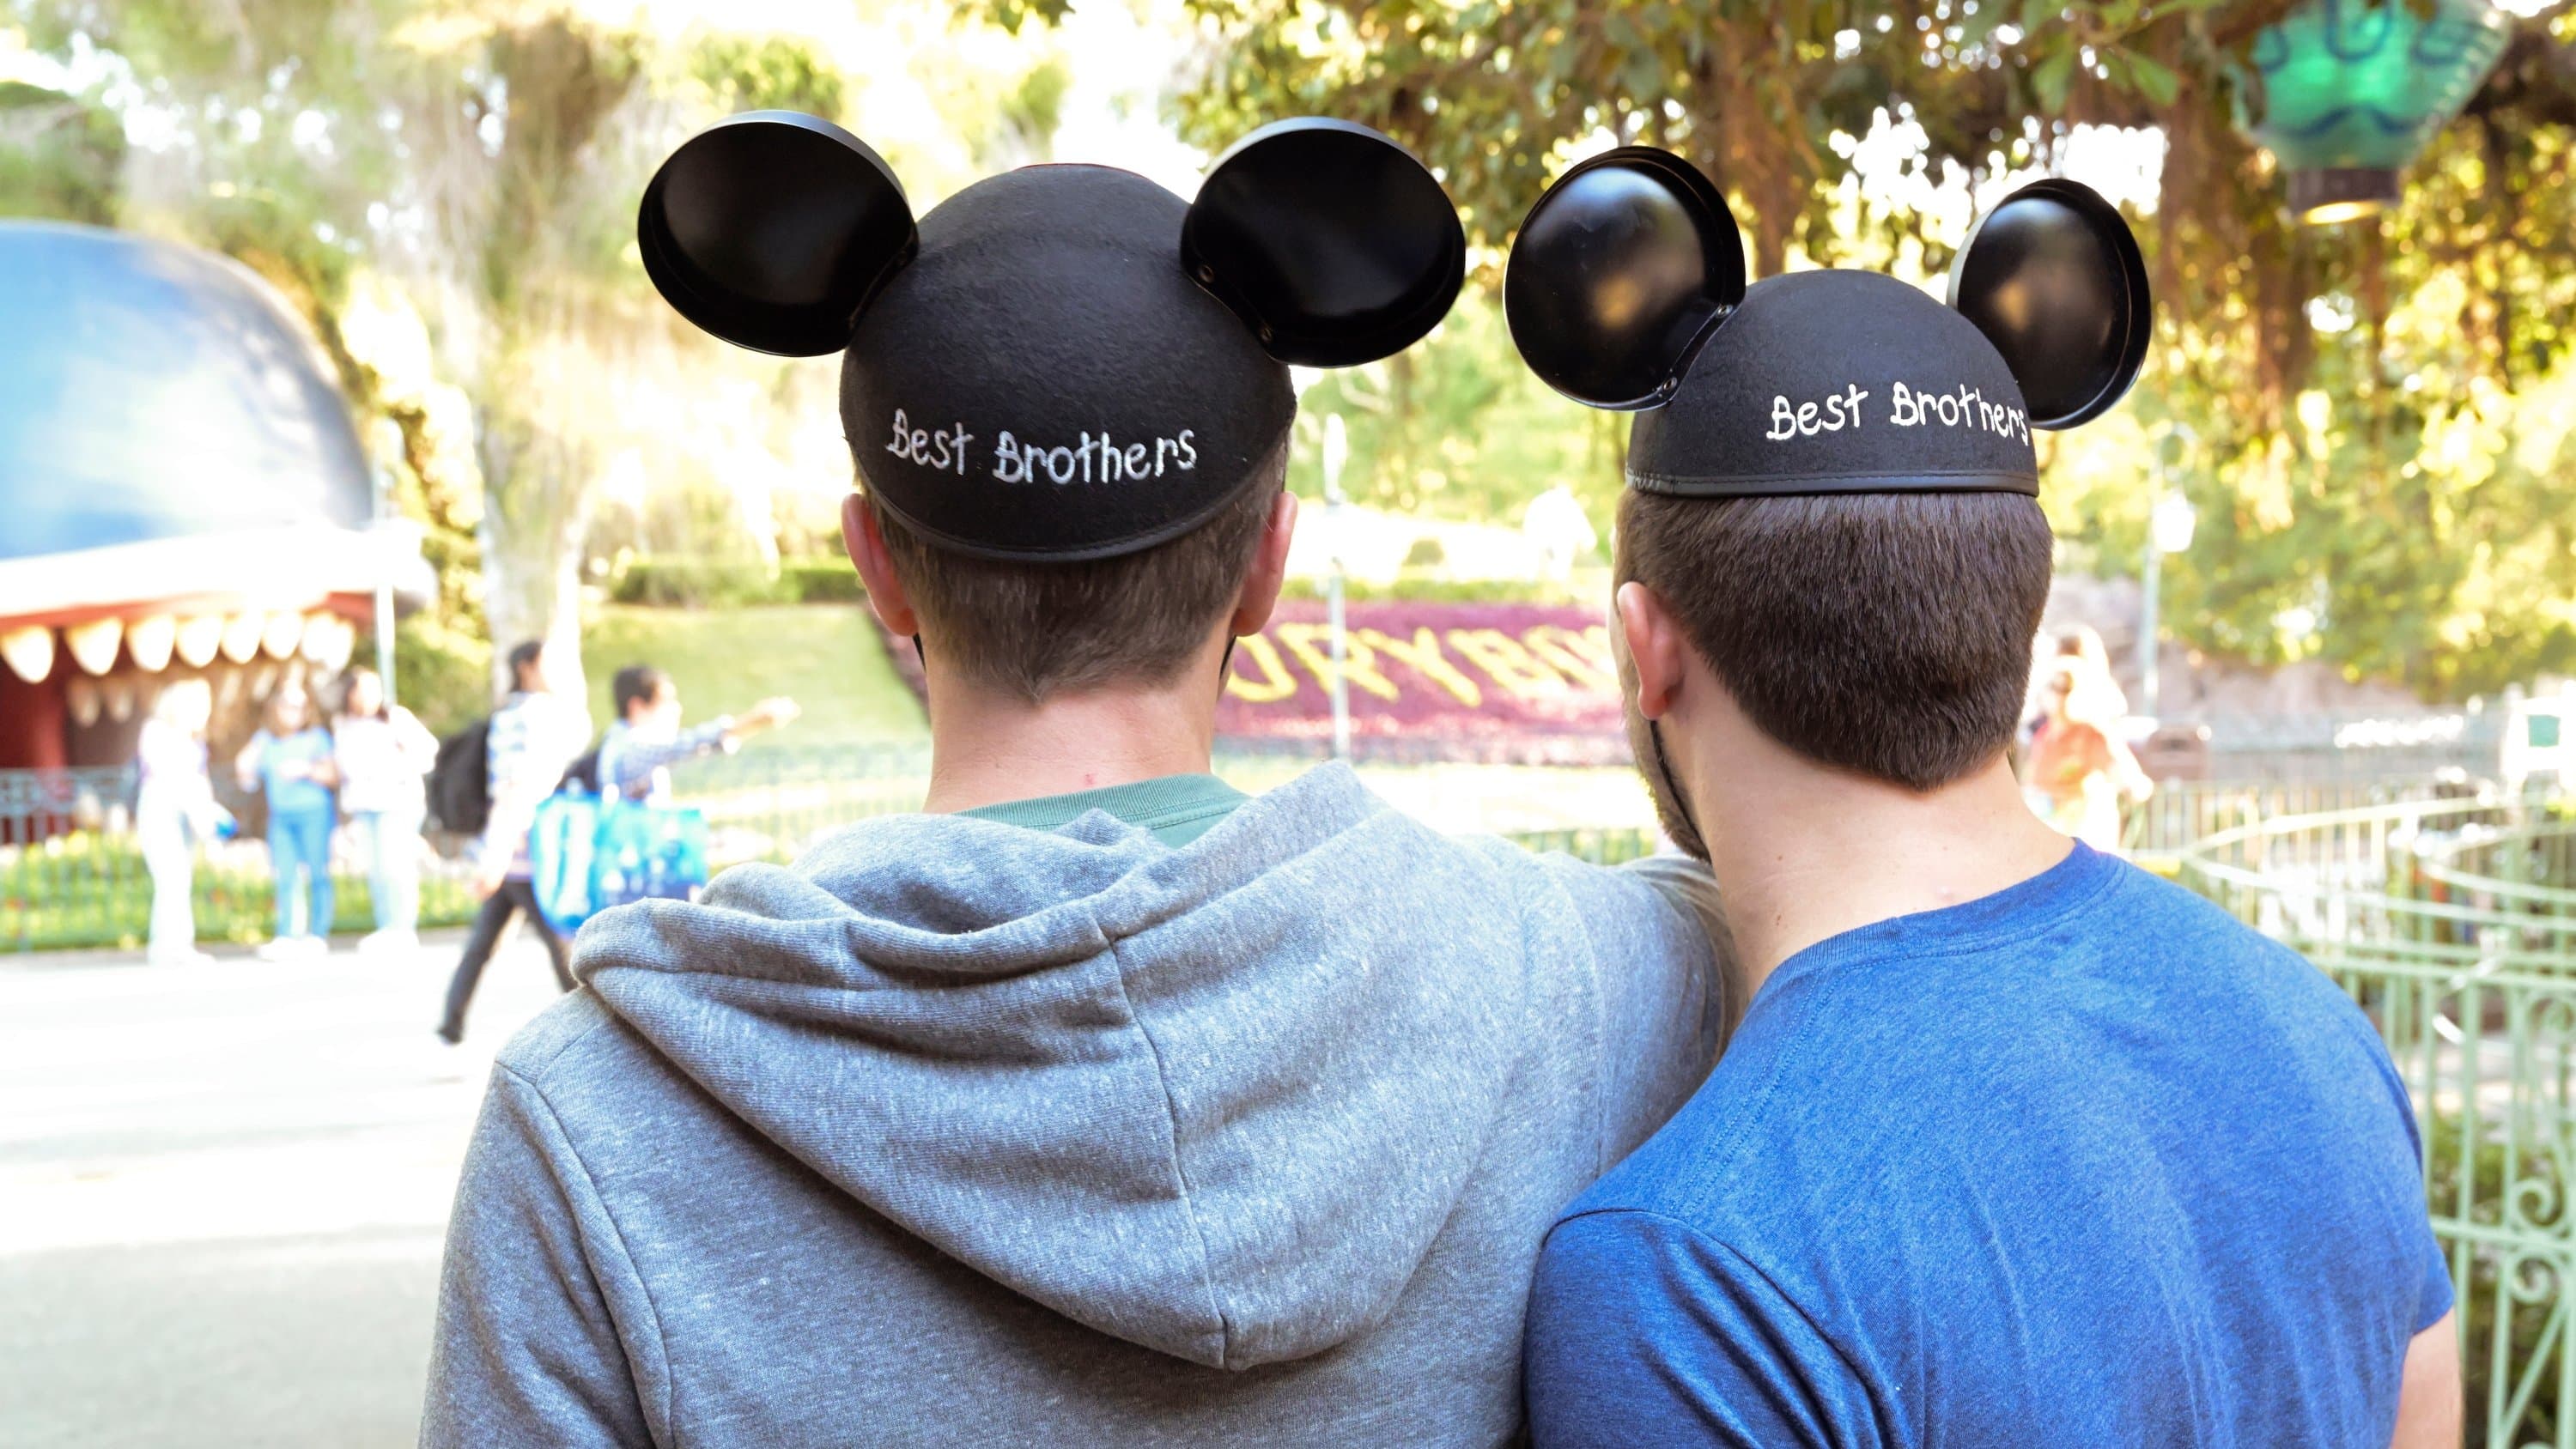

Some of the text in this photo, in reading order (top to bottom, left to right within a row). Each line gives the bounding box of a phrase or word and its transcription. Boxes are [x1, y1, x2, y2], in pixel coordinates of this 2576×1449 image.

[885, 408, 1198, 484] Best Brothers
[1765, 381, 2029, 447] Best Brothers
